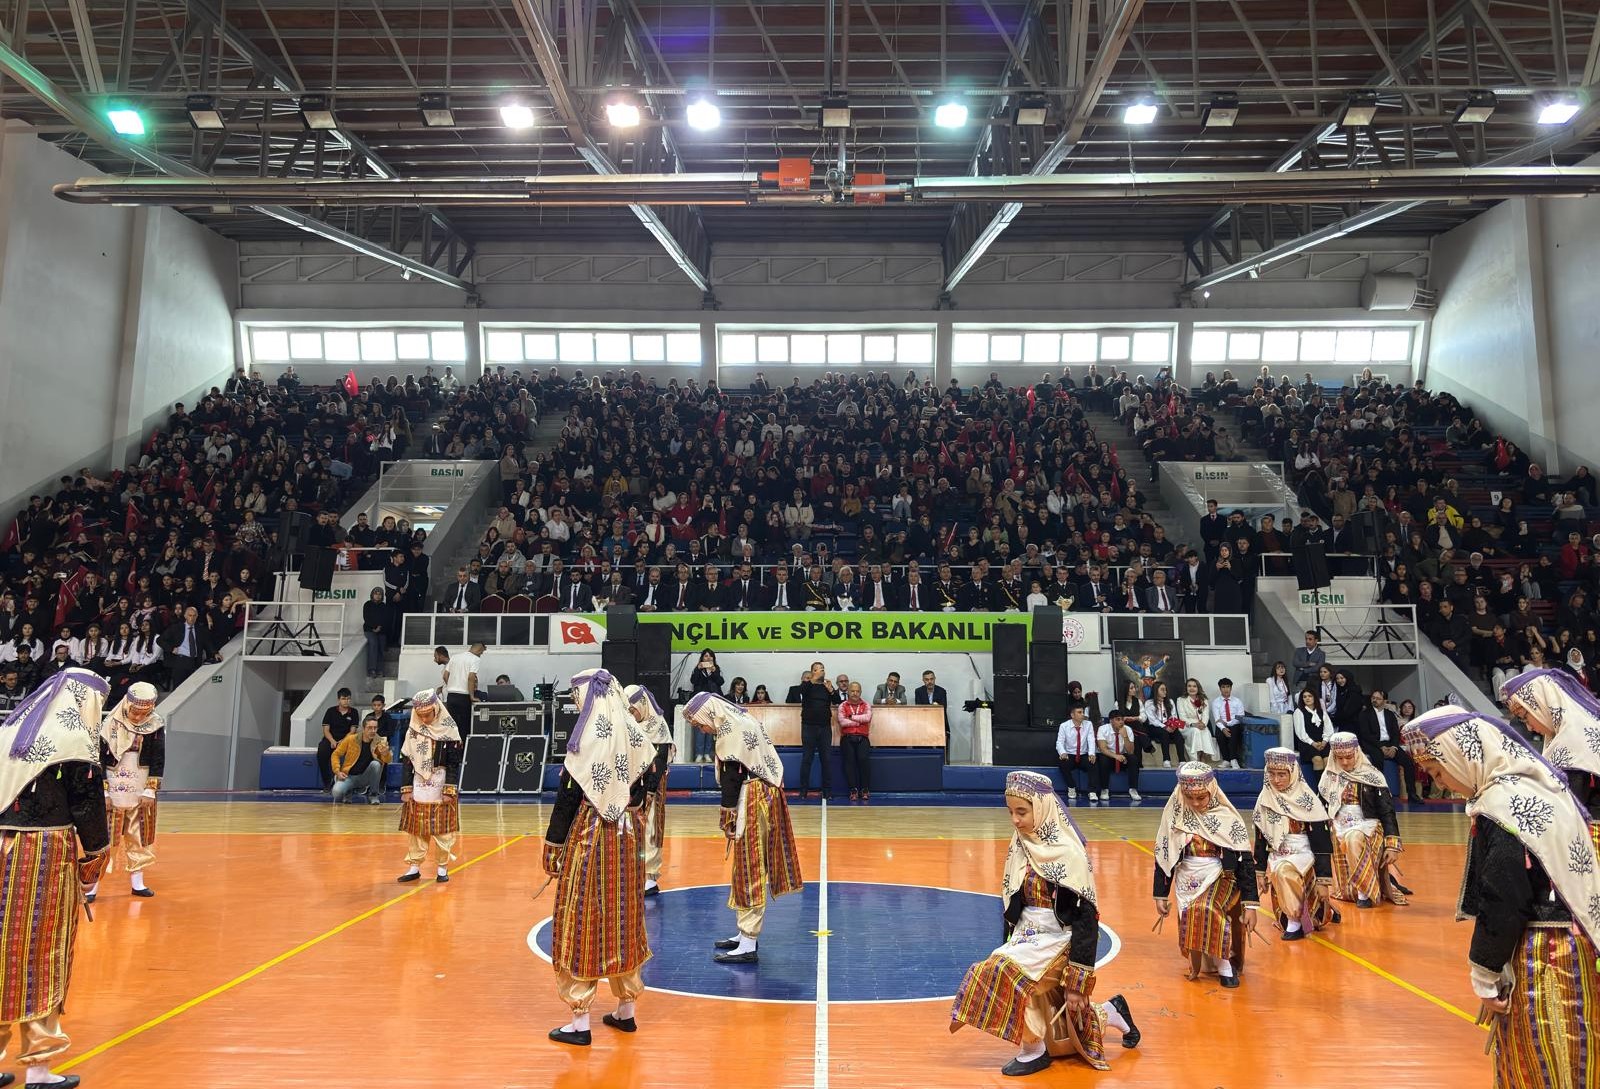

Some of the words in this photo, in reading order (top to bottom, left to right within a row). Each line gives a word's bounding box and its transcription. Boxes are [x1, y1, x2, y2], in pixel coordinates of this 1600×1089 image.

[431, 468, 464, 477] BASIN
[1195, 471, 1229, 480] BASIN
[315, 589, 356, 599] BASIN
[1301, 594, 1344, 604] BASIN
[671, 618, 749, 645] NÇLİK
[757, 626, 782, 640] VE
[791, 621, 863, 640] SPOR
[871, 617, 1006, 640] BAKANLI
